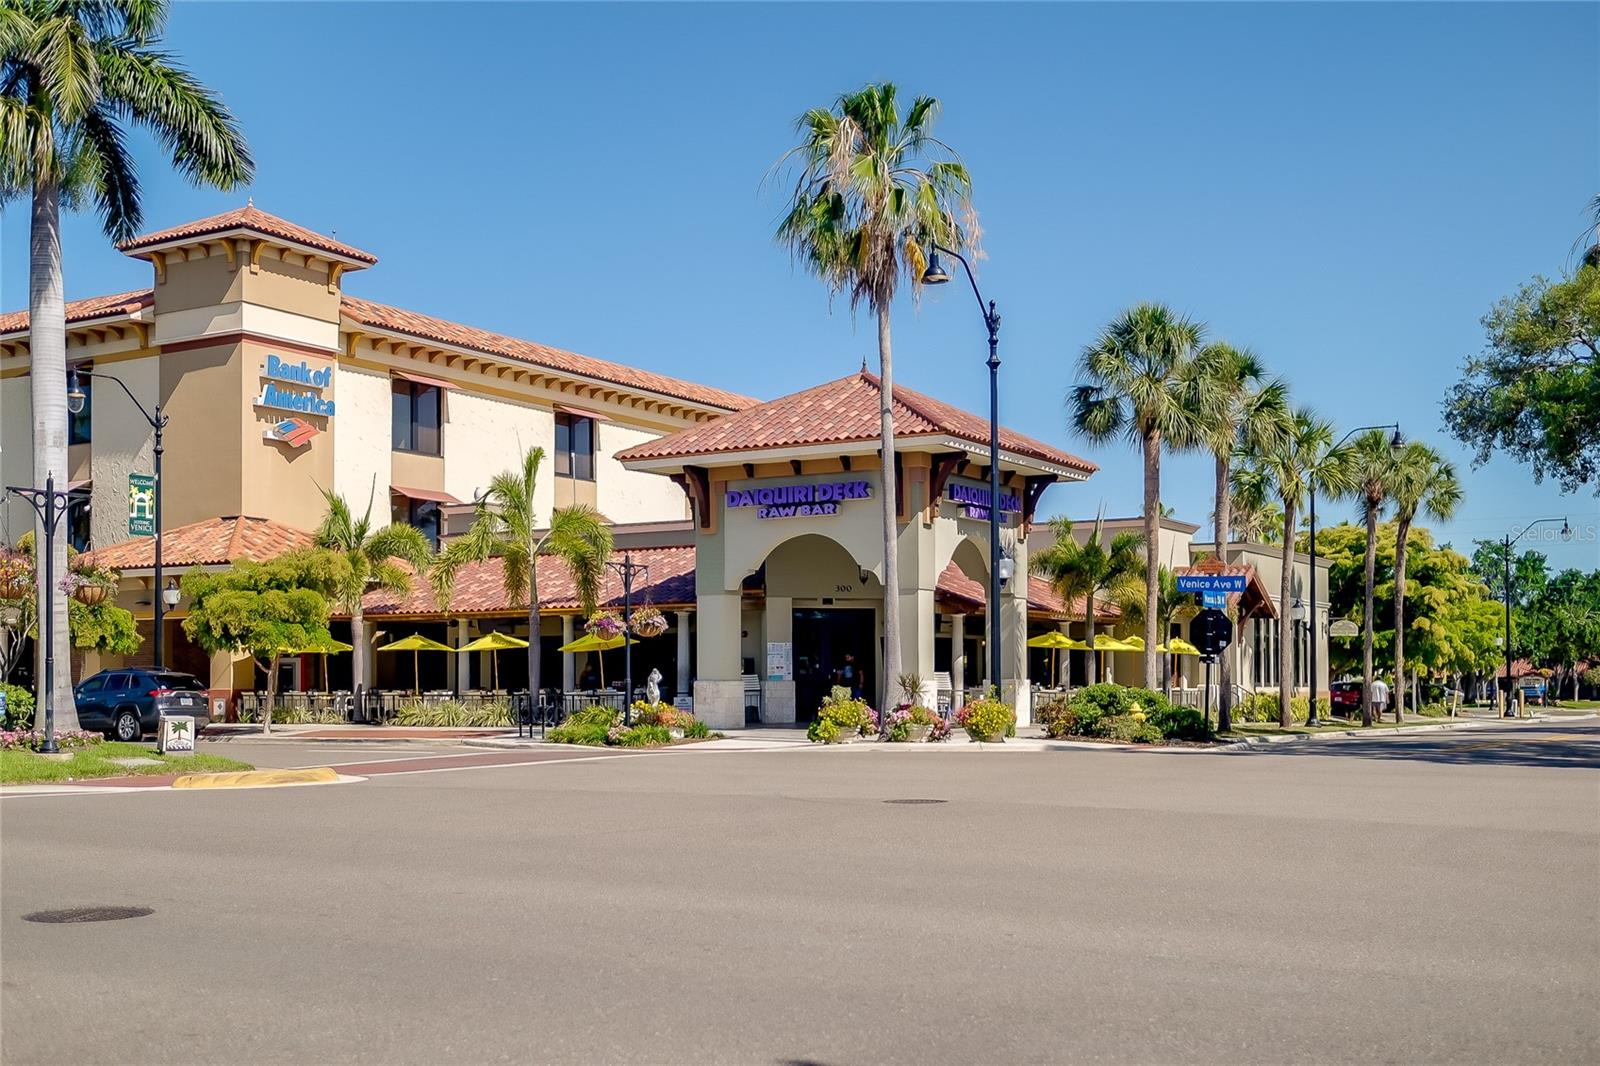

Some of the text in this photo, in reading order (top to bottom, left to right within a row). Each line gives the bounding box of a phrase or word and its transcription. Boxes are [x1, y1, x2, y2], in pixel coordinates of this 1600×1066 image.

[267, 354, 331, 388] Bank of
[263, 383, 335, 416] America
[726, 480, 870, 508] DAIQUIRI DECK
[757, 503, 837, 518] RAW BAR
[131, 523, 153, 532] VENICE
[1180, 580, 1242, 589] Venice Ave W
